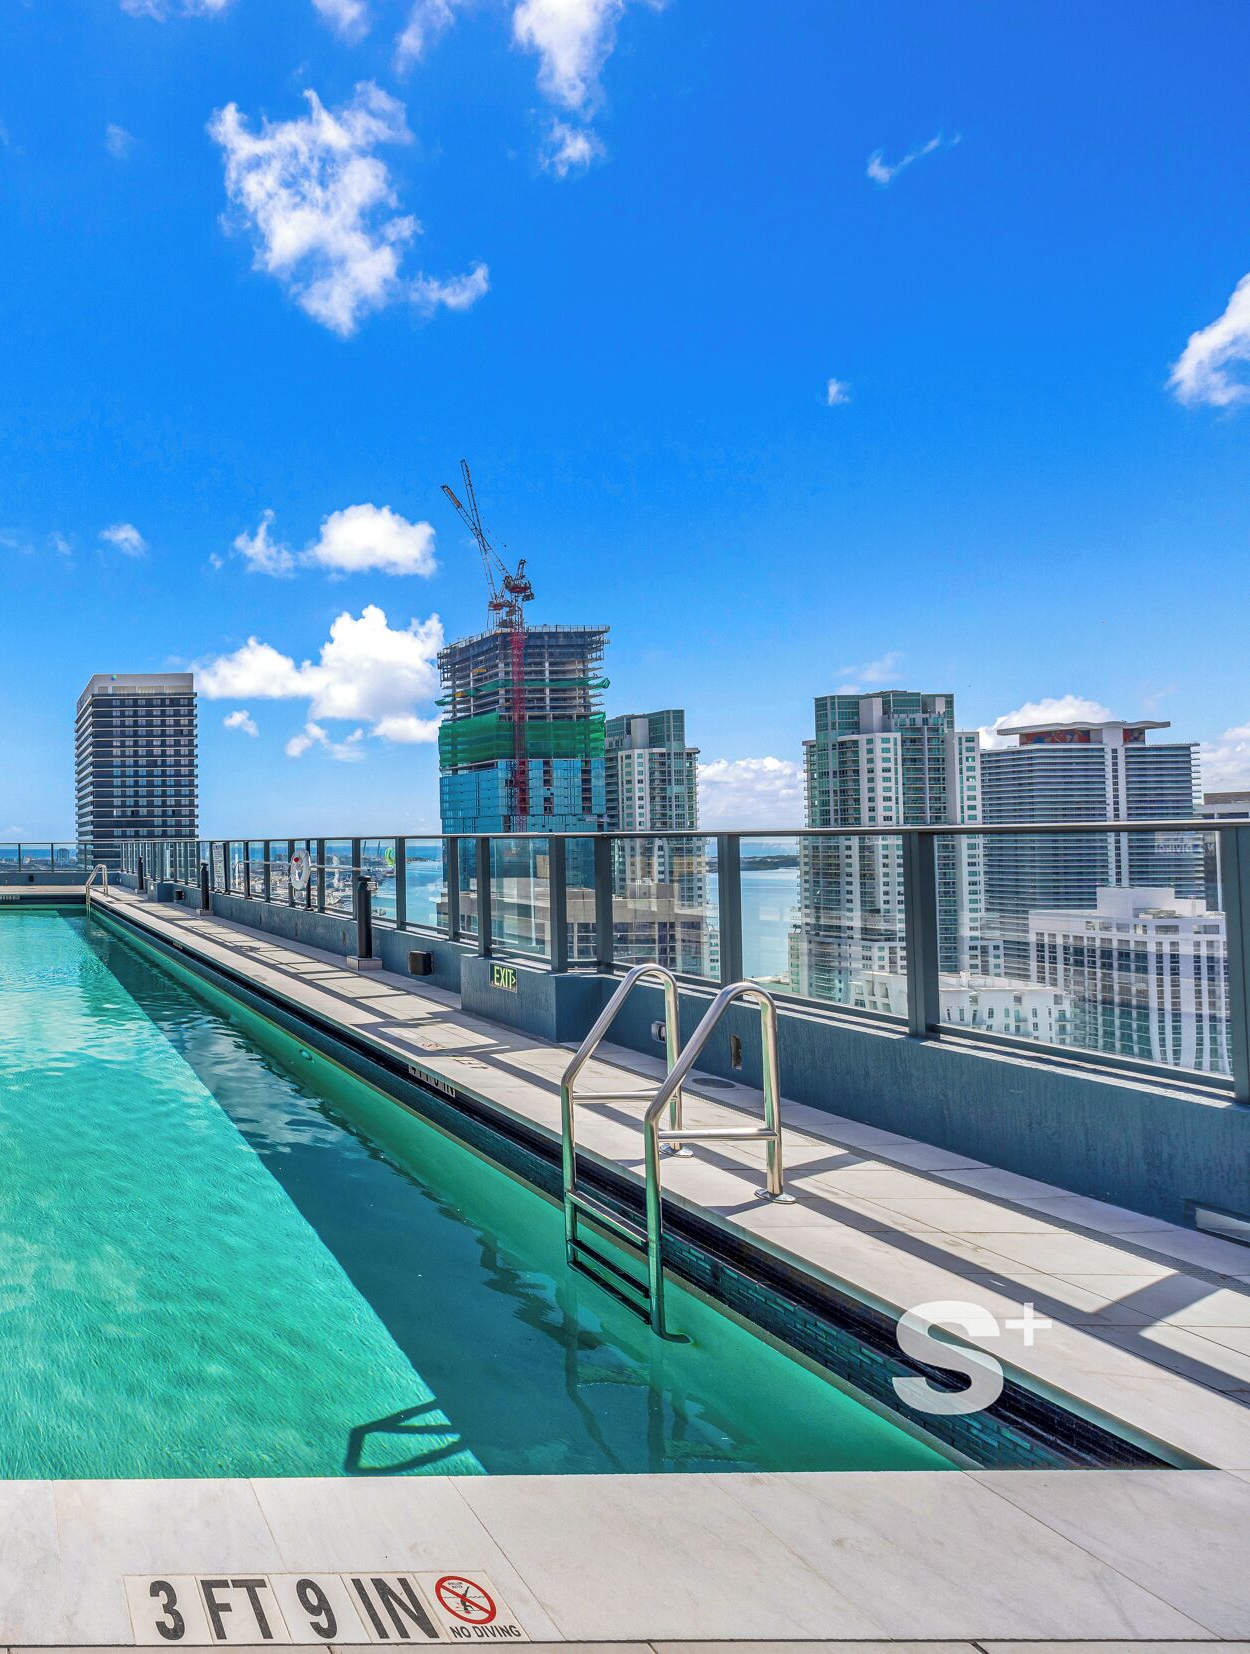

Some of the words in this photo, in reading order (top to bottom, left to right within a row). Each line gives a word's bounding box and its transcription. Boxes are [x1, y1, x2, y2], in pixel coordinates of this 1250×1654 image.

[494, 965, 514, 989] EXIT
[149, 1579, 185, 1641] 3
[200, 1578, 274, 1640] FT
[295, 1578, 338, 1640] 9
[350, 1577, 440, 1639] IN
[449, 1625, 472, 1639] NO
[472, 1624, 522, 1638] DIVING
